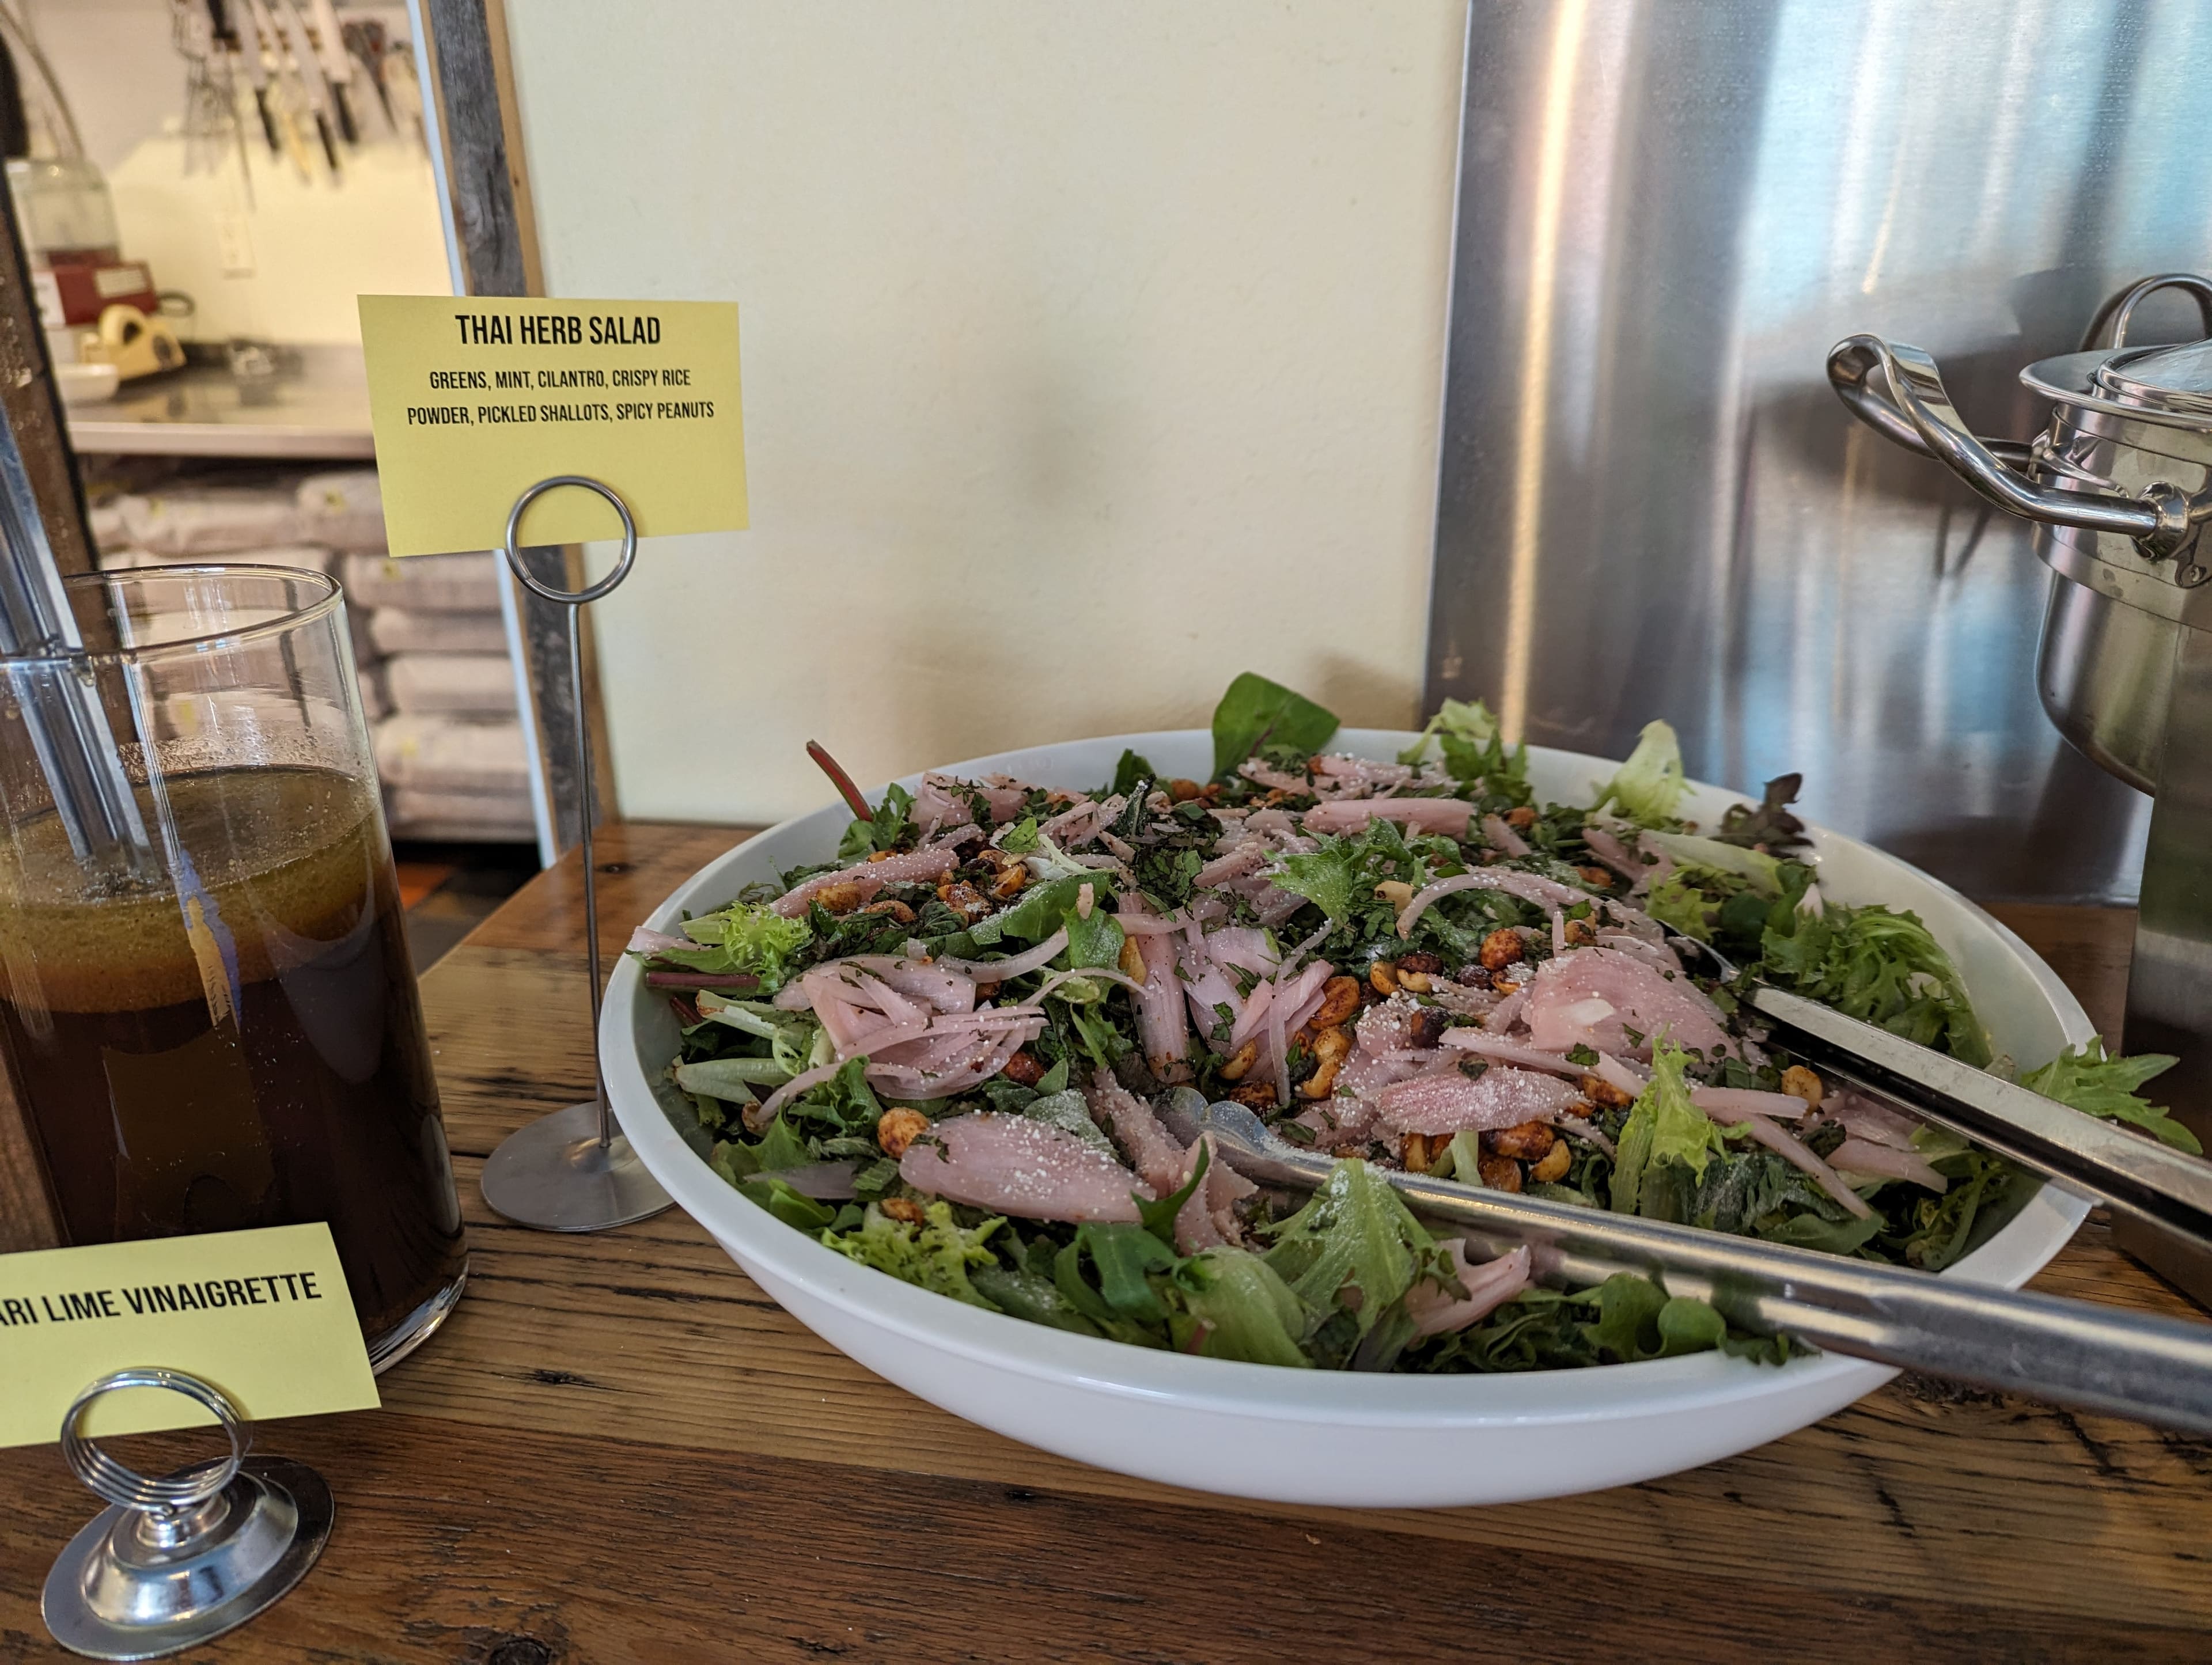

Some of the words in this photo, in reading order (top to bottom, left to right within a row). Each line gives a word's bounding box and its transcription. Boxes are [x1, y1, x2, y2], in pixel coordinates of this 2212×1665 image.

[454, 314, 513, 345] THAI
[520, 315, 582, 345] HERB
[589, 316, 661, 345] SALAD
[429, 371, 492, 392] GREENS,
[495, 370, 534, 391] MINT,
[537, 370, 609, 390] CILANTRO,
[612, 370, 658, 388] CRISPY
[662, 369, 691, 386] RICE
[407, 407, 474, 427] POWDER,
[478, 405, 537, 424] PICKLED
[540, 403, 613, 423] SHALLOTS,
[616, 403, 653, 421] SPICY
[657, 401, 714, 420] PEANUTS
[41, 1290, 122, 1322] LIME
[121, 1272, 322, 1314] VINAIGRETTE
